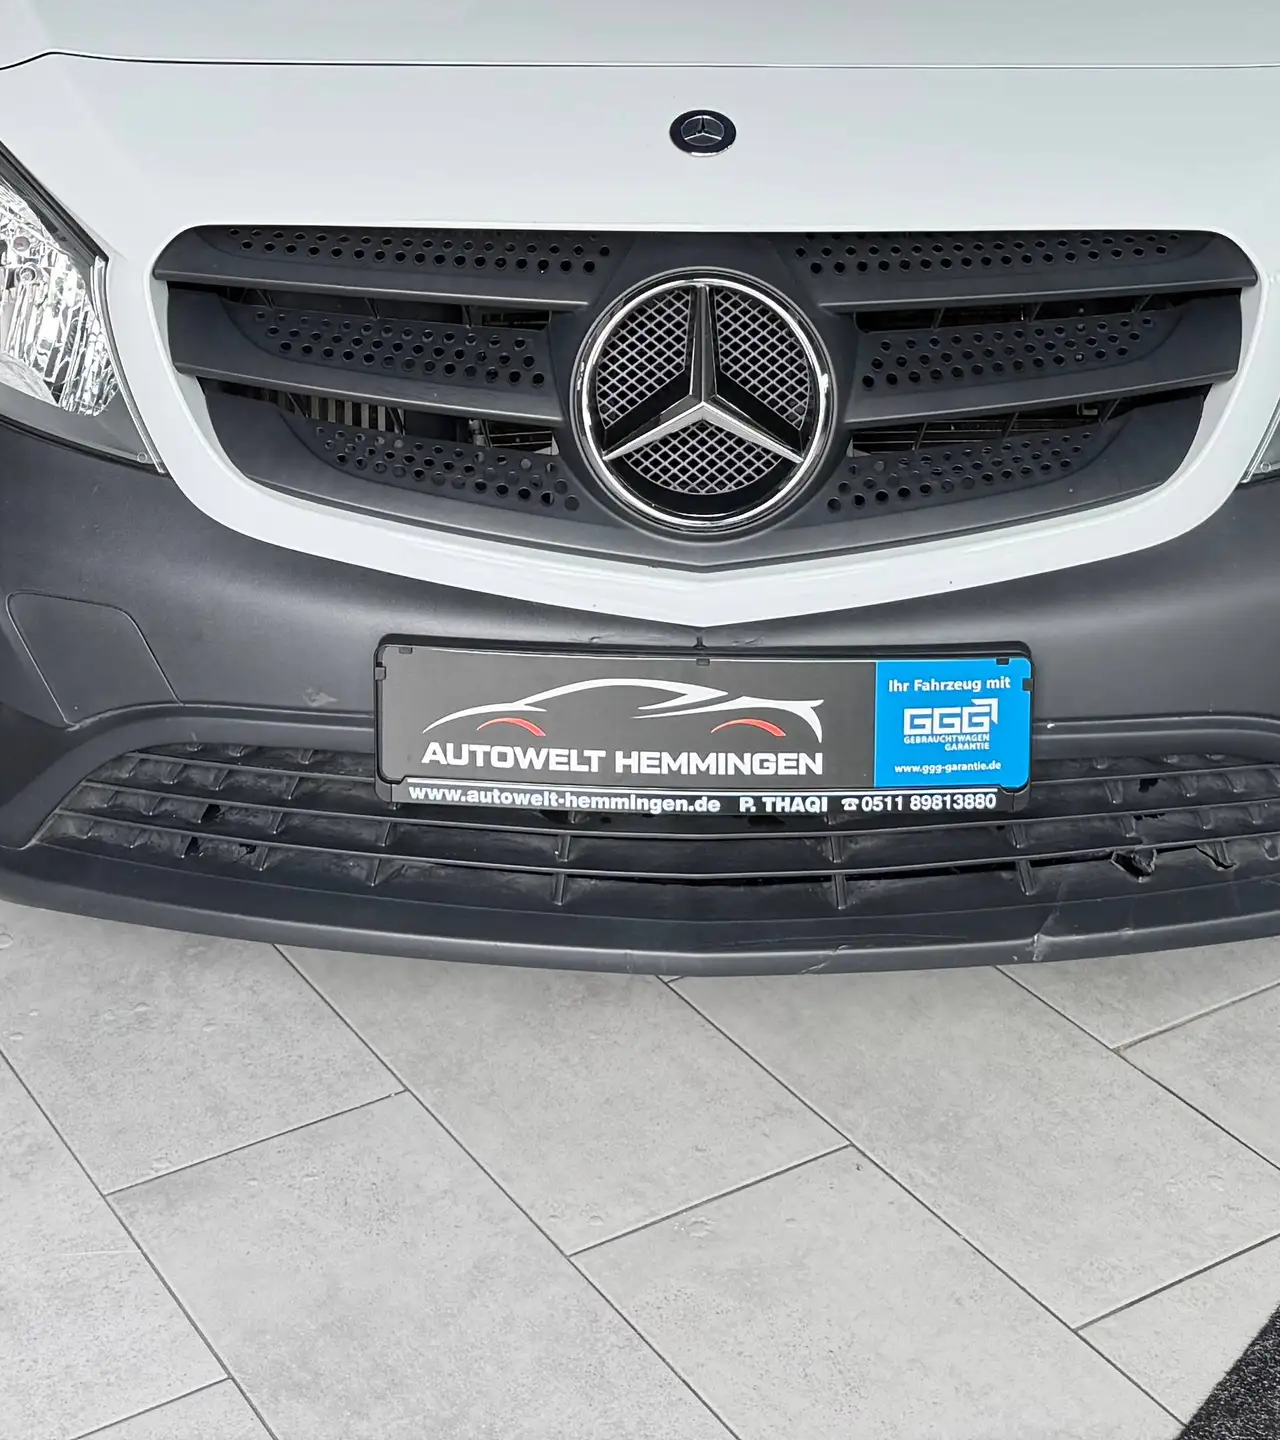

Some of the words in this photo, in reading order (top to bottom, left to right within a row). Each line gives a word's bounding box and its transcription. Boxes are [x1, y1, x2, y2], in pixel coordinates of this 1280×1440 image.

[888, 679, 910, 692] Ihr
[914, 678, 981, 693] Fahrzeug
[986, 676, 1011, 689] mit
[903, 705, 991, 735] GGG
[903, 733, 990, 744] GEBRAUCHTWAGEN
[944, 742, 990, 751] GARANTIE
[421, 741, 606, 773] AUTOWELT
[615, 750, 823, 776] HEMMINGEN
[894, 760, 1001, 774] www.ggg-garantie.de
[408, 785, 721, 814] www.autowelt-hemmingen.de
[739, 796, 756, 812] P.
[762, 796, 828, 812] THAQI
[861, 795, 904, 812] 0511
[910, 793, 997, 810] 89813880
